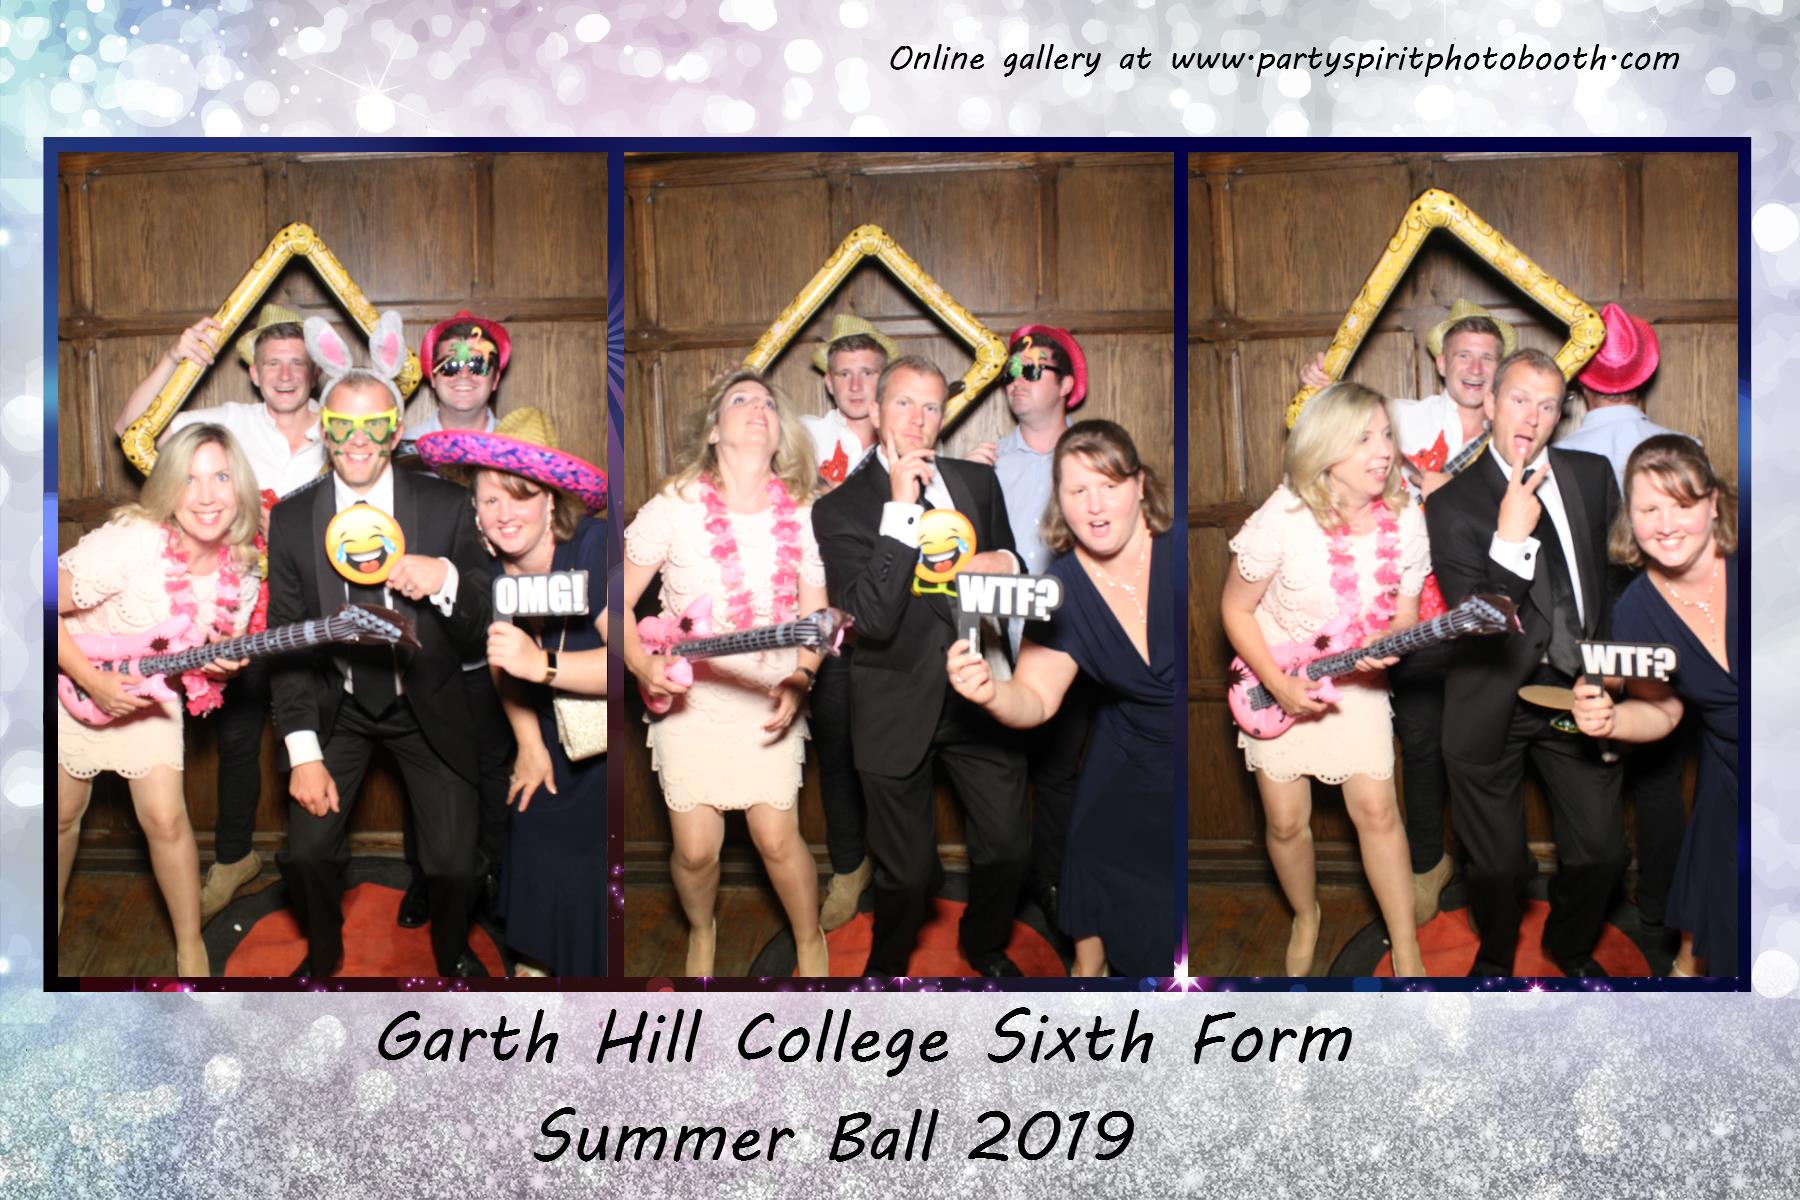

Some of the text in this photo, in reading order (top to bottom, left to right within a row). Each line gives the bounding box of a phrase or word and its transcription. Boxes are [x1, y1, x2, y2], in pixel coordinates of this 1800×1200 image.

[495, 574, 586, 615] OMG!
[957, 574, 1061, 617] WTF?
[1580, 643, 1677, 679] WTF?
